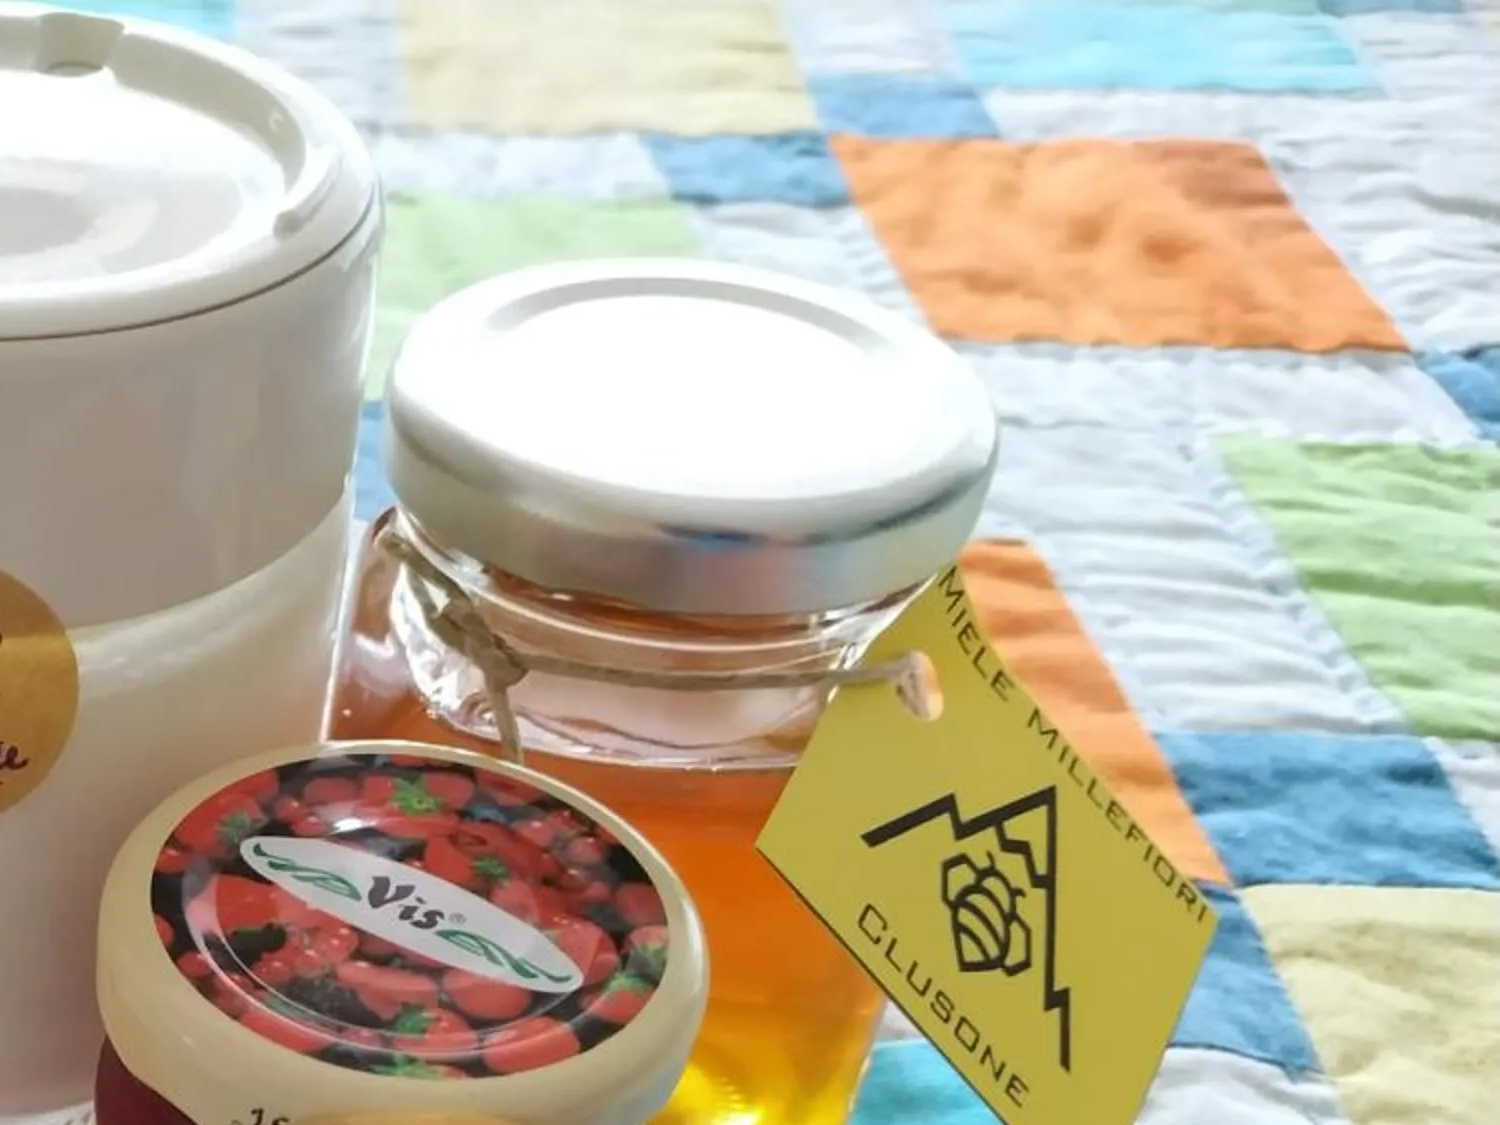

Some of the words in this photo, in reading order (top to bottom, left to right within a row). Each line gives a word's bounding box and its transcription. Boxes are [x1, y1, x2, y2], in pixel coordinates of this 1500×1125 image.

[937, 564, 1016, 703] MIELE
[1026, 707, 1208, 923] MILLEFIORI
[367, 875, 445, 930] Vis
[857, 903, 1031, 1109] CLUSONE
